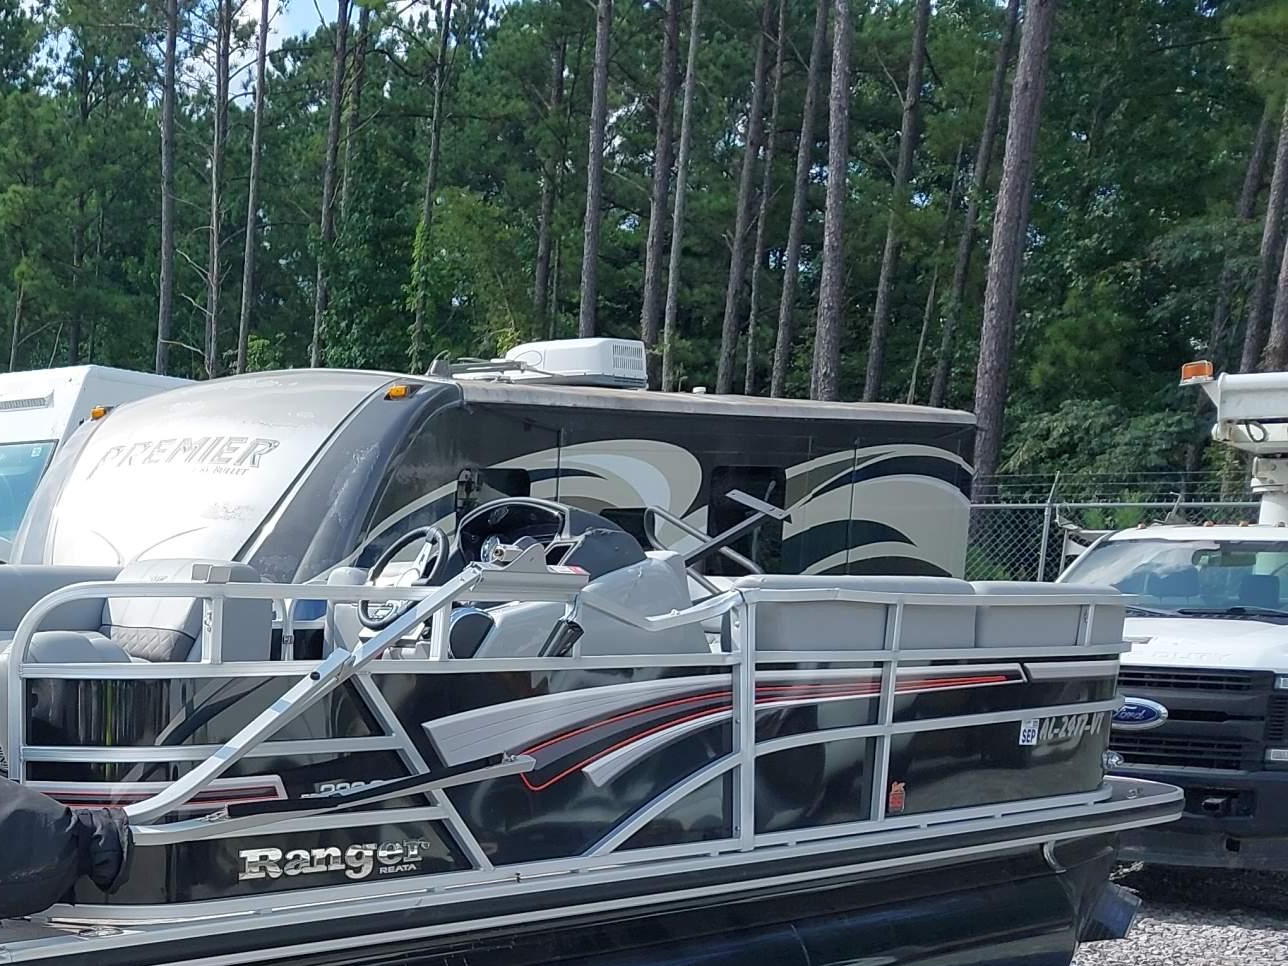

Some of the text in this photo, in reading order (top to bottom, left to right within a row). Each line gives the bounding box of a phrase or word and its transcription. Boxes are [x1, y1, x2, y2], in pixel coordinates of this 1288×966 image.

[86, 436, 281, 480] PREMIER
[1113, 705, 1145, 720] Ford
[1021, 728, 1037, 744] SEP
[238, 838, 430, 881] Ranger
[379, 863, 417, 875] REATA
